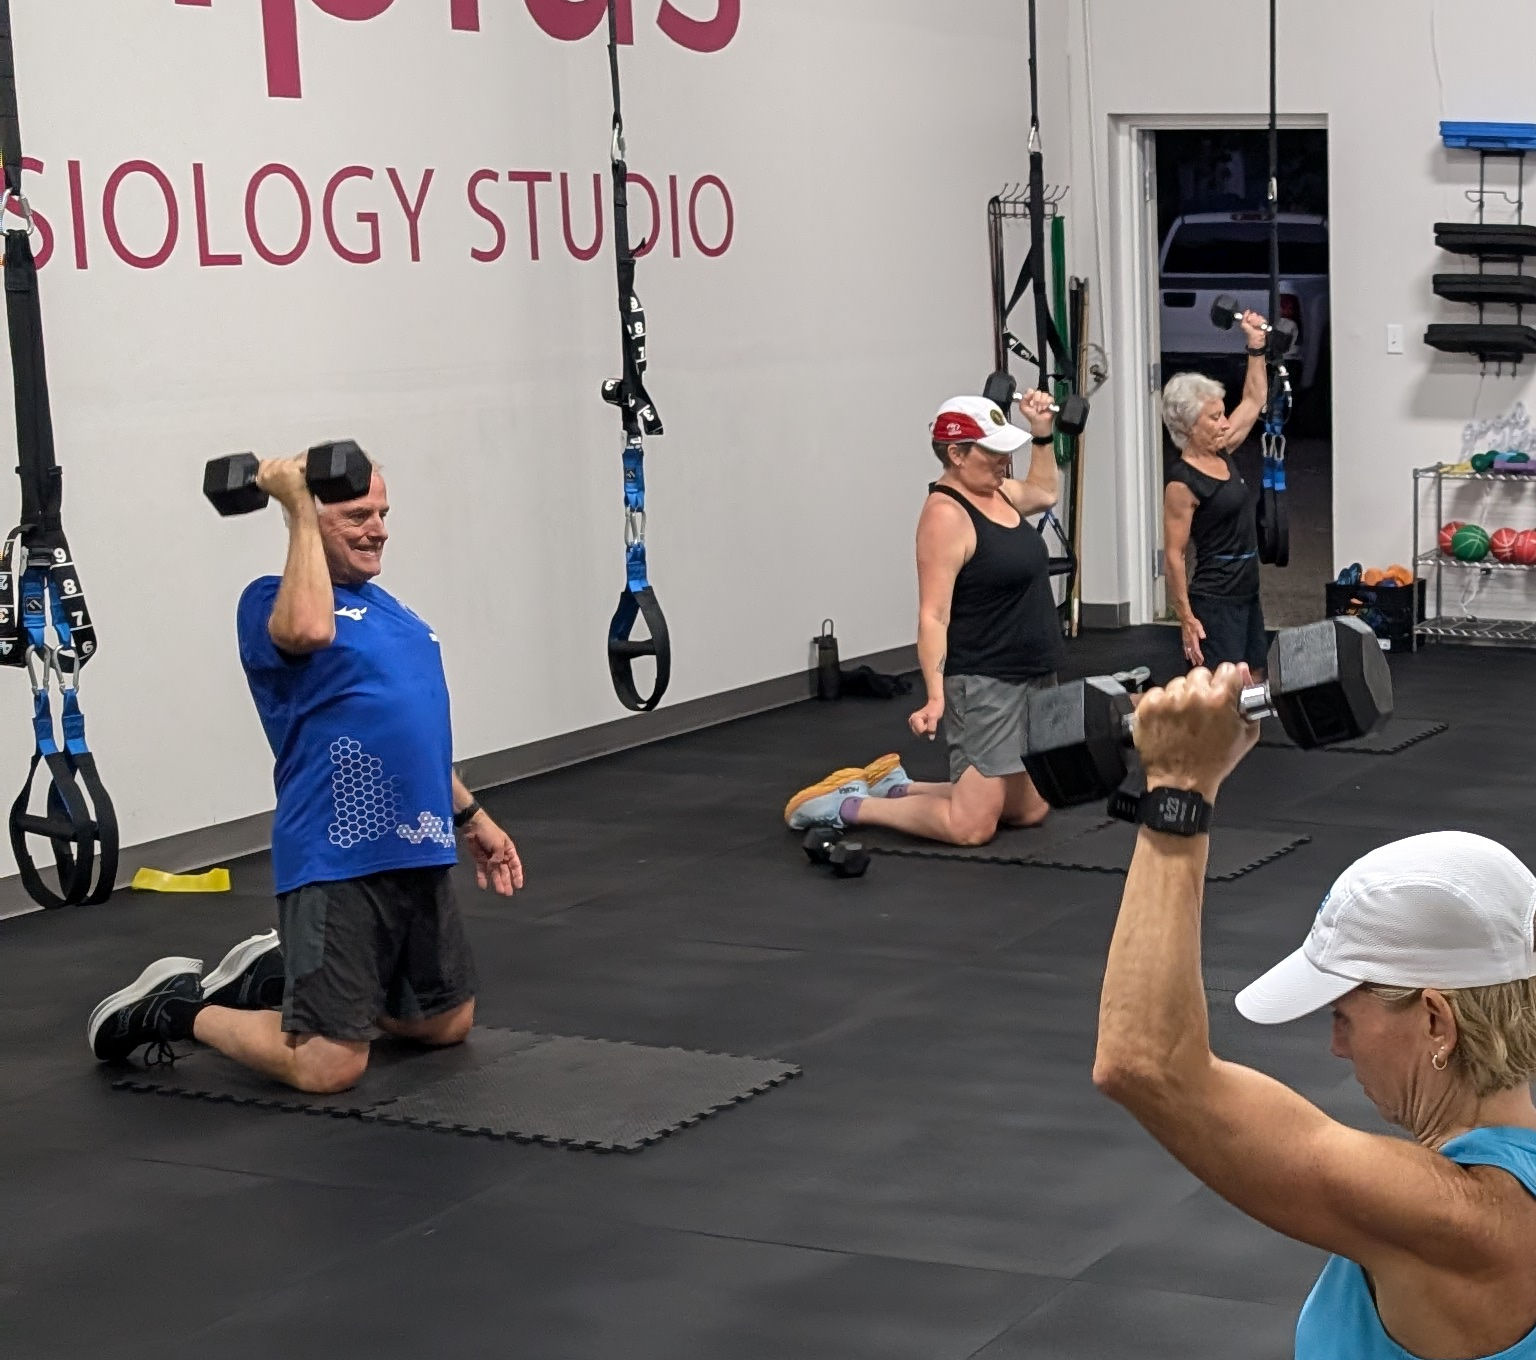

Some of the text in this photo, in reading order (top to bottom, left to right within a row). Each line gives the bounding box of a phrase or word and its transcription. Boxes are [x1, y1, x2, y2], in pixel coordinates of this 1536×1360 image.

[468, 169, 734, 262] STUDIO
[634, 321, 644, 335] 8
[53, 547, 67, 563] 9
[63, 579, 77, 595] 8
[71, 611, 84, 627] 7
[82, 641, 94, 654] 6
